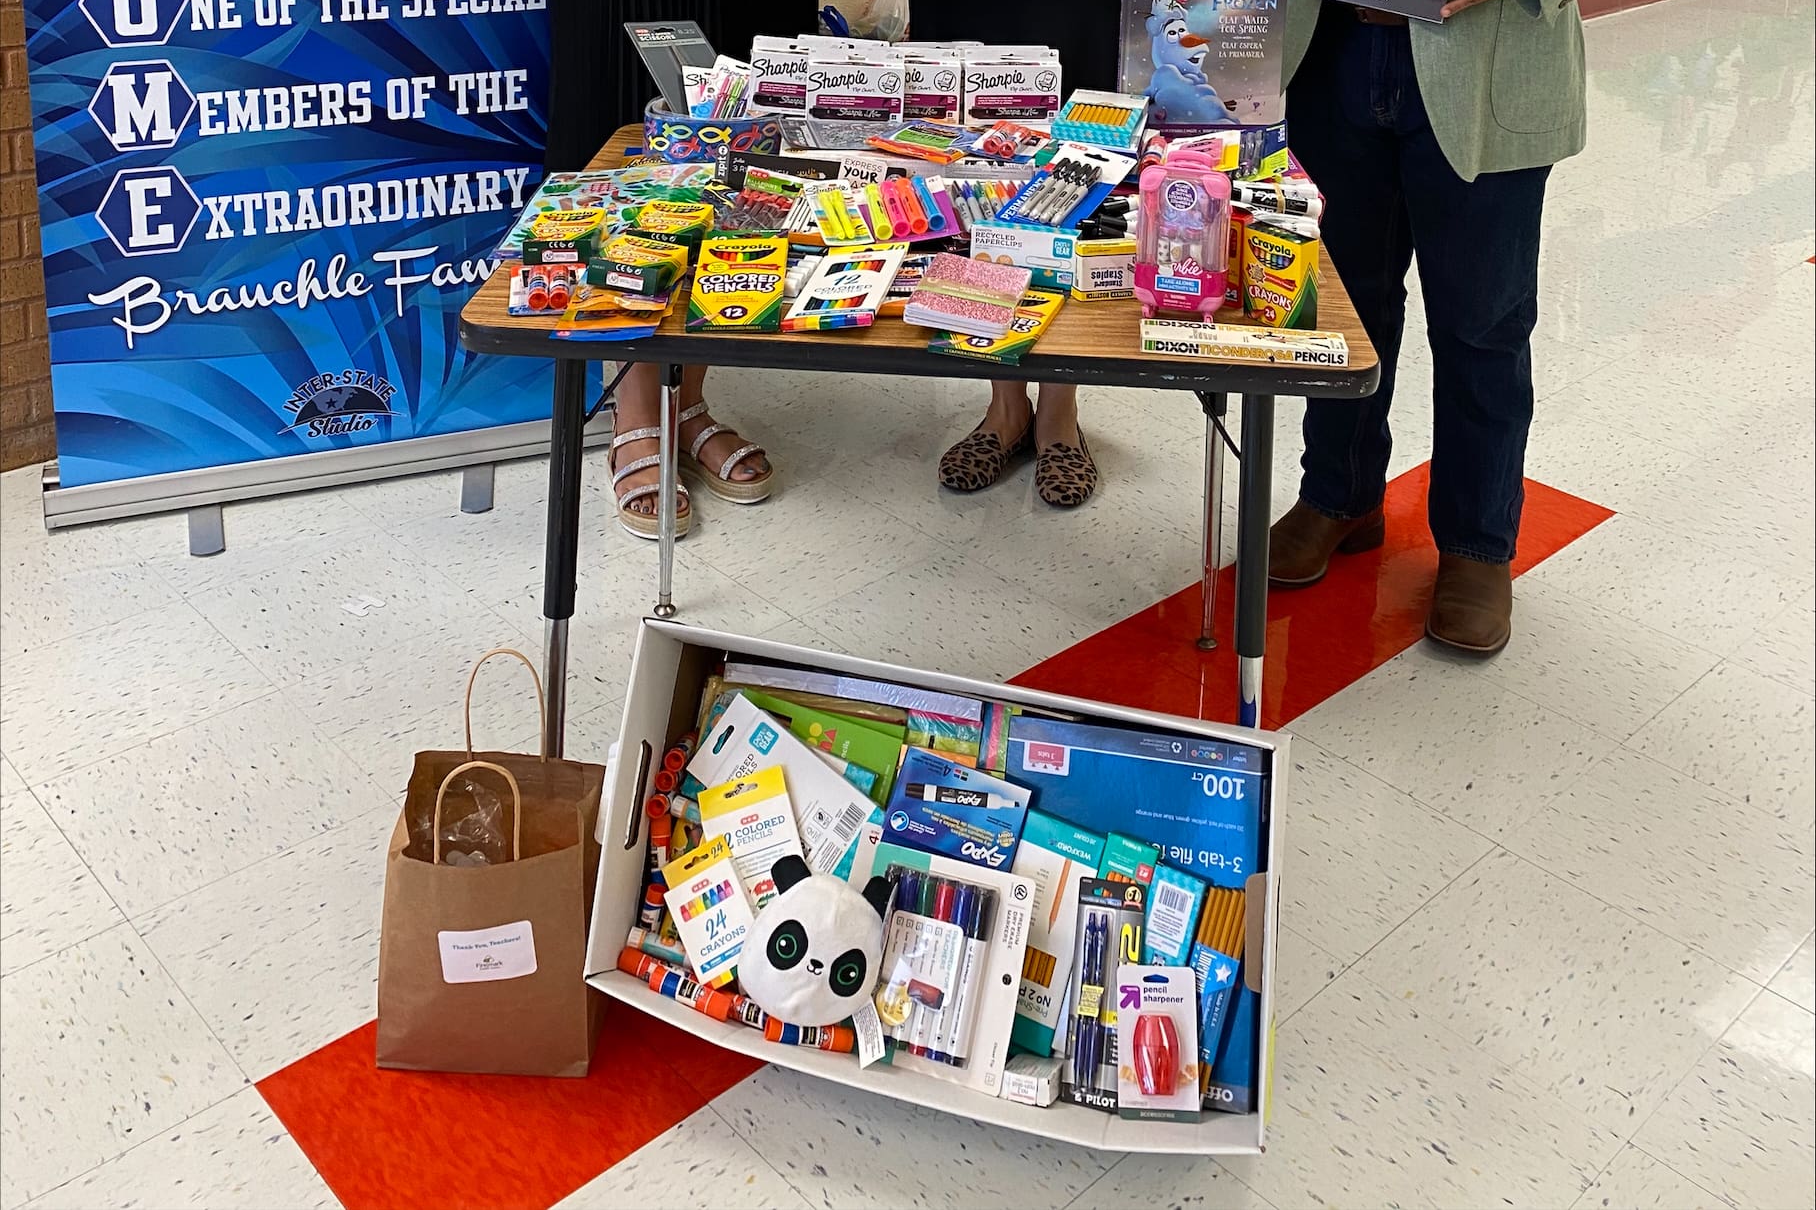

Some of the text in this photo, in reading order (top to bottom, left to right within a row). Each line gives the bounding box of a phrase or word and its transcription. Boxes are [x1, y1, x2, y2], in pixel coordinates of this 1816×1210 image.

[1238, 24, 1268, 34] SPRING
[752, 58, 808, 78] Sharpie
[808, 69, 869, 92] Sharpie
[965, 69, 1026, 94] Sharpie
[106, 68, 529, 145] MEMBERS OF THE
[844, 158, 883, 172] EXPRESS
[1000, 177, 1045, 221] PERMANENT
[1255, 191, 1276, 201] EXP
[124, 167, 530, 249] EXTRAORDINARY
[975, 231, 1016, 241] RECYCLED
[975, 238, 1023, 248] PAPERCLIPS
[1252, 236, 1291, 256] Crayola
[699, 274, 780, 285] COLORED
[834, 274, 861, 286] 12
[1091, 270, 1123, 280] Staples
[702, 281, 775, 293] PENCILS
[1094, 280, 1123, 288] Standard
[88, 245, 502, 350] Brauchle Fam
[1249, 285, 1293, 311] CRAYONS
[724, 307, 744, 317] 12
[1265, 307, 1275, 318] 24
[1158, 320, 1217, 330] DIXON
[971, 337, 989, 346] 12
[1155, 339, 1345, 366] DIXON TICONDEROGA PENCILS
[307, 414, 377, 438] Studio
[943, 764, 951, 777] 4
[1202, 773, 1245, 800] 100
[957, 794, 982, 806] EXPO
[735, 815, 786, 838] COLORED
[736, 828, 774, 847] PENCILS
[868, 834, 880, 845] 4
[711, 842, 724, 859] 24
[961, 842, 1007, 867] EXPO
[1057, 841, 1092, 861] WEXFORD
[1170, 846, 1194, 865] file
[1198, 850, 1243, 873] 3-tab
[705, 909, 728, 941] 24
[1003, 910, 1011, 942] MARKERS
[1014, 912, 1024, 945] PREMIUM
[489, 935, 521, 947] Teachers!
[700, 925, 746, 958] CRAYONS
[1027, 989, 1036, 1000] 2
[1143, 986, 1168, 996] pencil
[1143, 996, 1185, 1006] sharpener
[1086, 1095, 1117, 1108] PILOT
